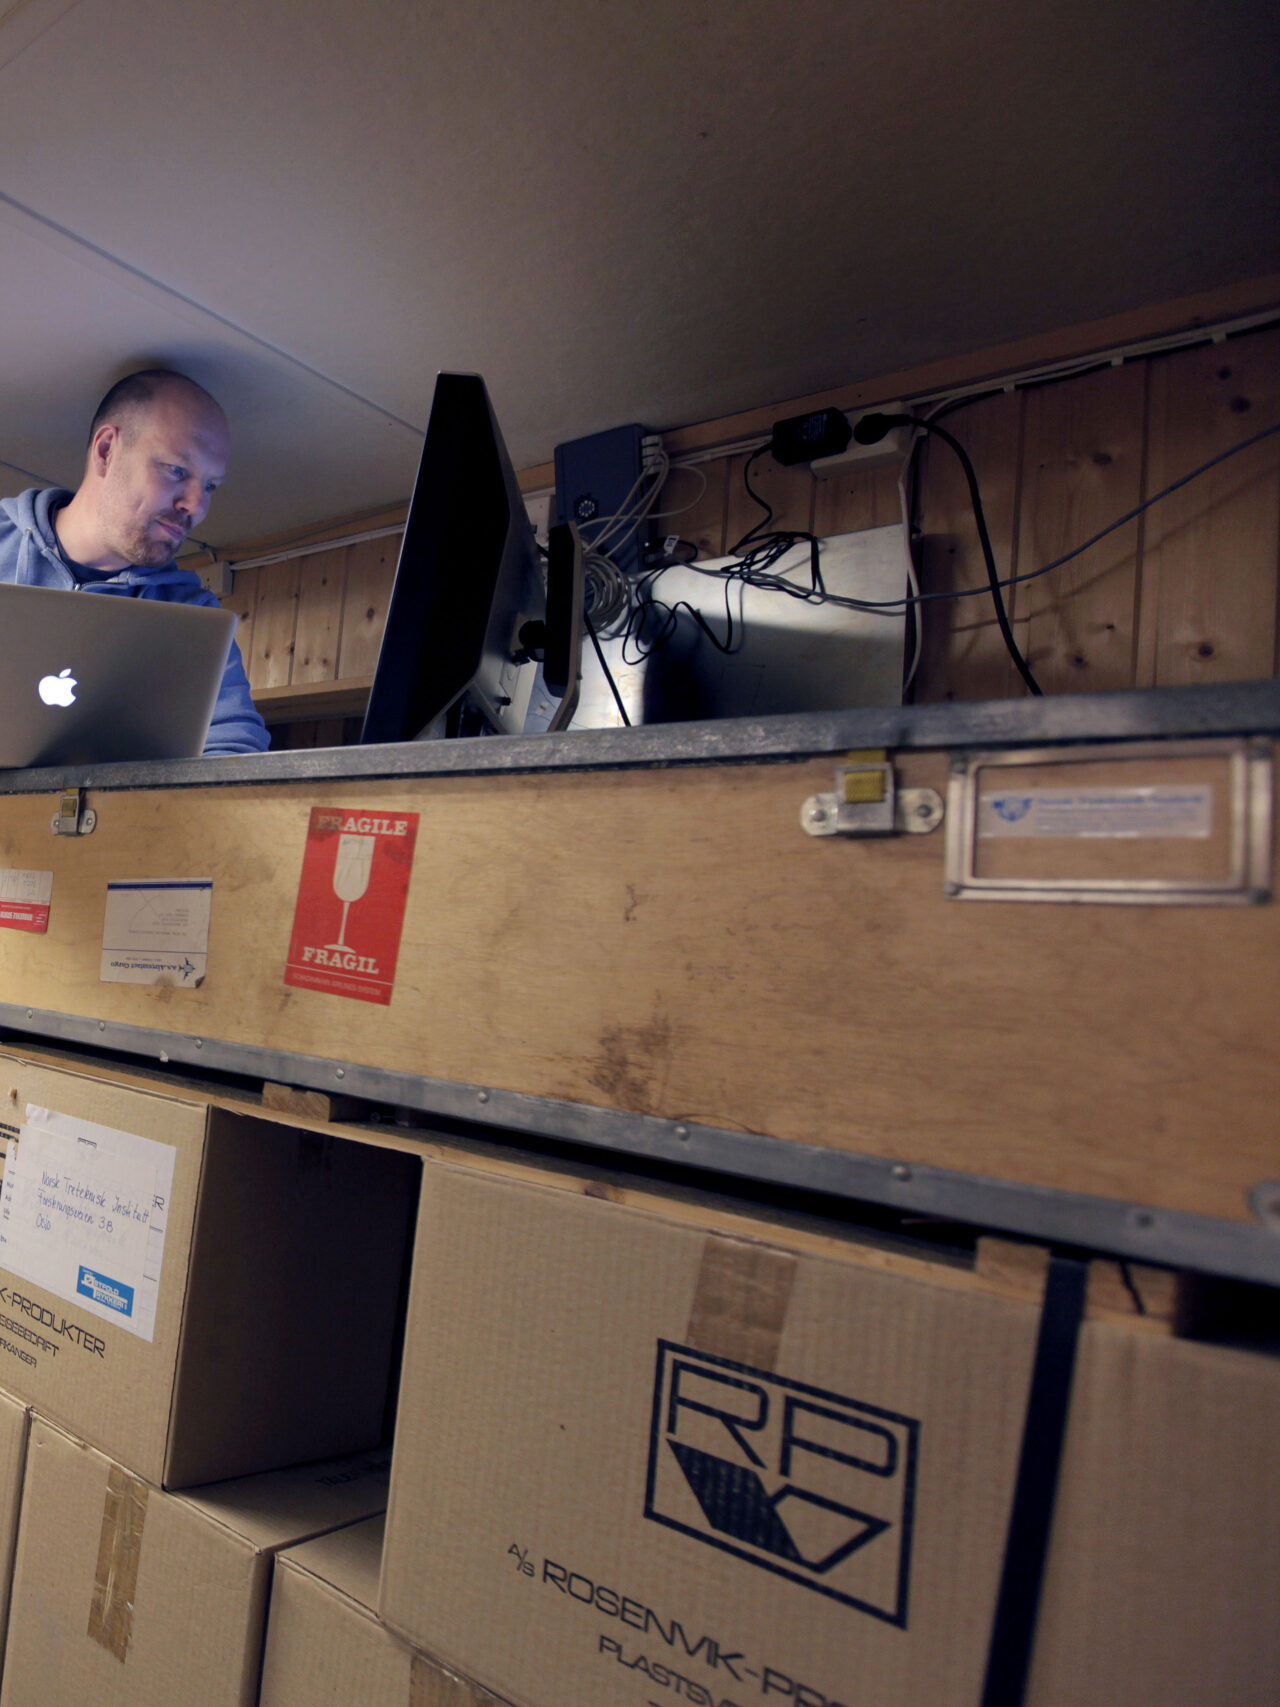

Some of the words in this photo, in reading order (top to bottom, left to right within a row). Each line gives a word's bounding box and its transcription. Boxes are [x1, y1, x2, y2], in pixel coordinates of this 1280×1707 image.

[317, 815, 408, 836] FRAGILE
[301, 946, 379, 974] FRAGIL
[41, 1171, 60, 1189] Norsk
